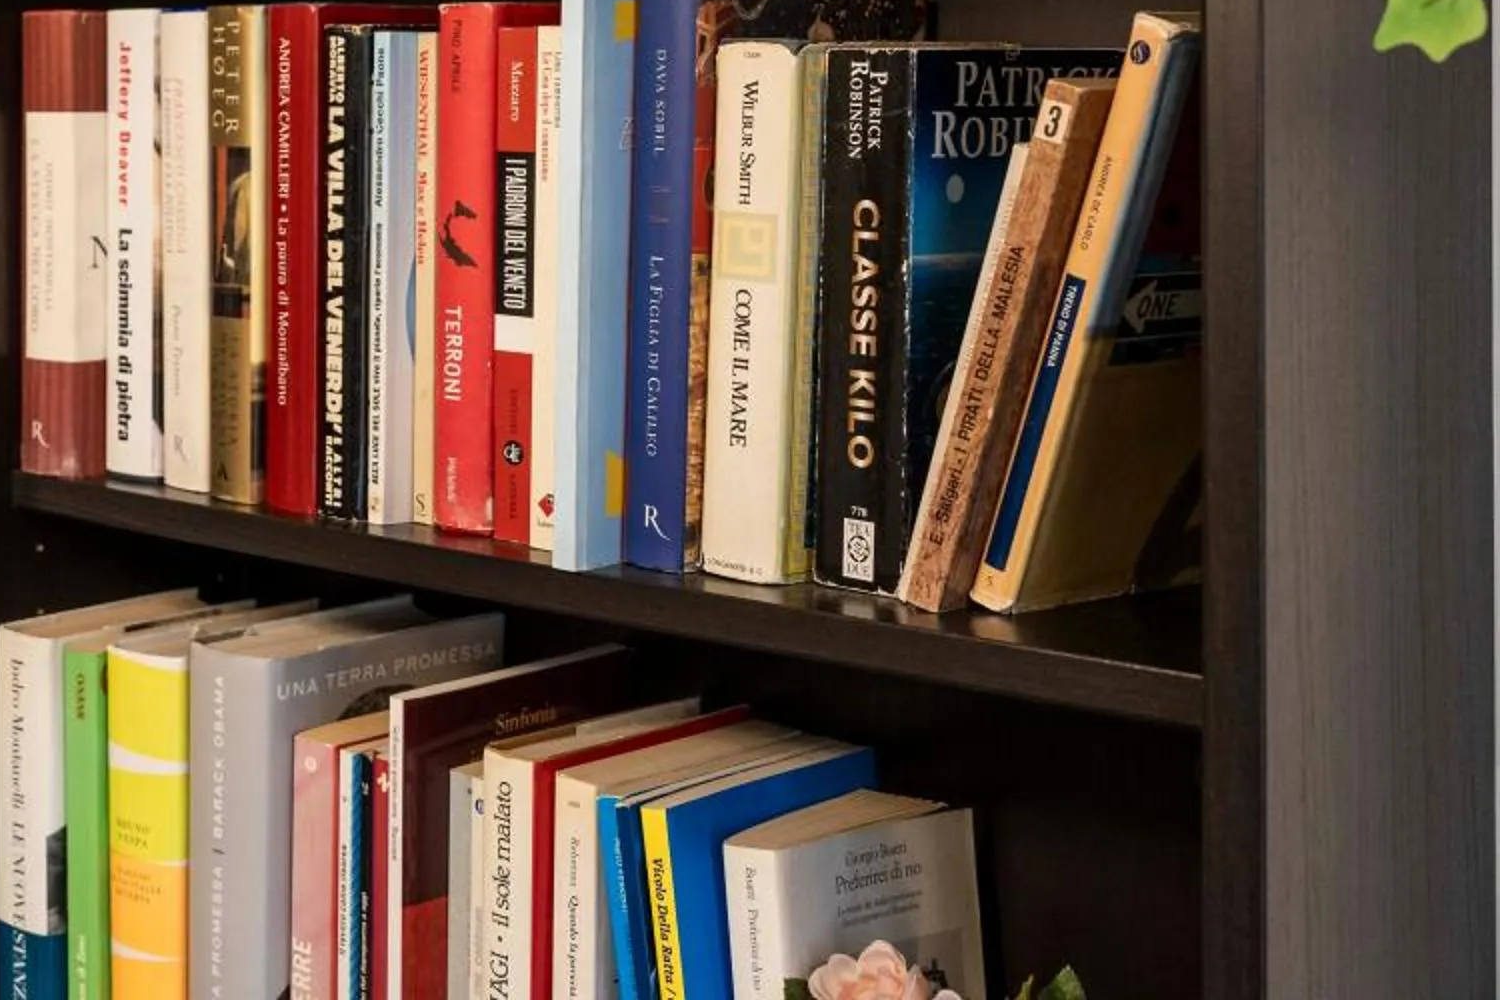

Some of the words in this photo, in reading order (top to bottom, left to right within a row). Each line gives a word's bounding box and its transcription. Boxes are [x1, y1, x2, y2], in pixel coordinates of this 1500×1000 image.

[116, 42, 132, 120] Jeffery
[225, 21, 241, 136] PETER
[278, 37, 291, 106] ANDREA
[654, 48, 668, 93] DAVA
[327, 105, 345, 145] LA
[653, 99, 667, 155] SOBEL
[740, 80, 759, 148] WILBUR
[847, 60, 869, 160] ROBINSON
[866, 71, 889, 151] PATRICK
[931, 110, 1041, 159] ROBI
[1043, 104, 1064, 139] 3
[117, 131, 132, 207] Deaver
[278, 110, 290, 199] CAMILLERI
[738, 152, 755, 206] SMITH
[327, 148, 345, 233] VILLA
[503, 167, 527, 225] PADRONI
[118, 227, 132, 252] La
[277, 218, 289, 235] La
[503, 228, 527, 255] DEL
[276, 241, 288, 286] paura
[326, 240, 344, 292] DEL
[503, 258, 527, 309] VENETO
[648, 255, 665, 279] LA
[849, 199, 881, 357] CLASSE
[117, 258, 132, 348] scimmia
[277, 291, 289, 306] di
[647, 285, 664, 344] FIGLIA
[733, 288, 753, 351] COME
[1137, 293, 1182, 320] ONE
[117, 354, 132, 375] di
[277, 311, 289, 405] Montalbano
[443, 306, 463, 401] TERRONI
[646, 351, 660, 370] DI
[732, 356, 750, 377] IL
[957, 392, 984, 442] PIRATI
[973, 325, 1002, 388] DELLA
[992, 245, 1026, 323] MALESIA
[115, 379, 132, 443] pietra
[645, 376, 661, 457] GALILEO
[729, 380, 749, 448] MARE
[846, 368, 876, 469] KILO
[644, 504, 672, 541] R
[276, 677, 319, 700] UNA
[323, 662, 388, 692] TERRA
[392, 640, 498, 677] PROMESSA
[211, 676, 226, 749] OBAMA
[211, 759, 226, 840] BARACK
[492, 781, 512, 863] malato
[491, 865, 510, 911] sole
[651, 857, 666, 901] Vicolo
[211, 867, 225, 978] PROMESSA
[492, 911, 510, 928] il
[656, 904, 671, 942] Della
[661, 945, 676, 985] Ratta
